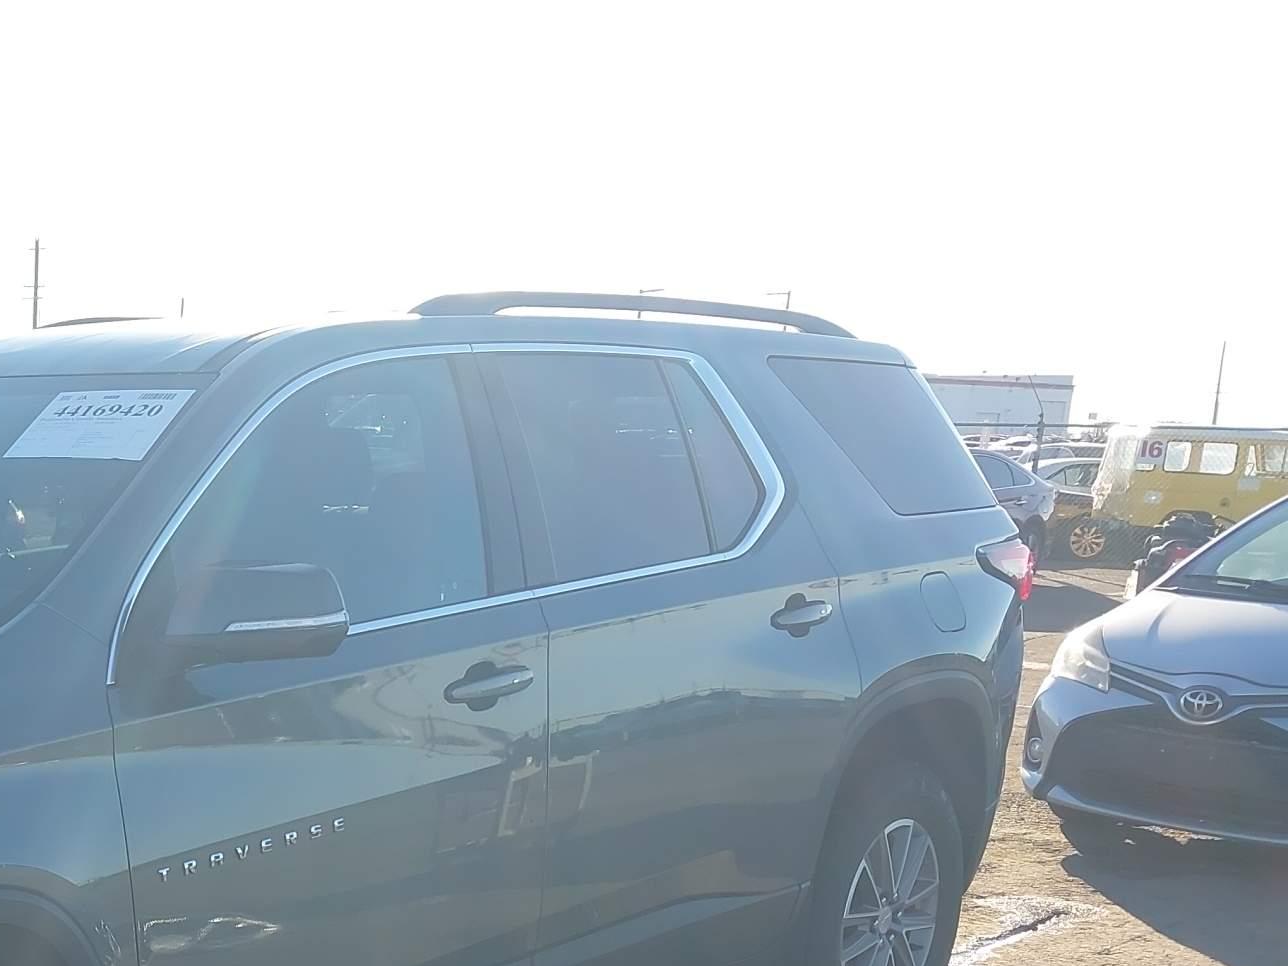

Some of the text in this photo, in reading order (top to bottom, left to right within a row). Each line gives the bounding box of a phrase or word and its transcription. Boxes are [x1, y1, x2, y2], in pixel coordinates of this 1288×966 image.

[52, 403, 164, 418] 44169420
[1139, 440, 1164, 459] 16
[157, 817, 345, 882] TRAVERSE
